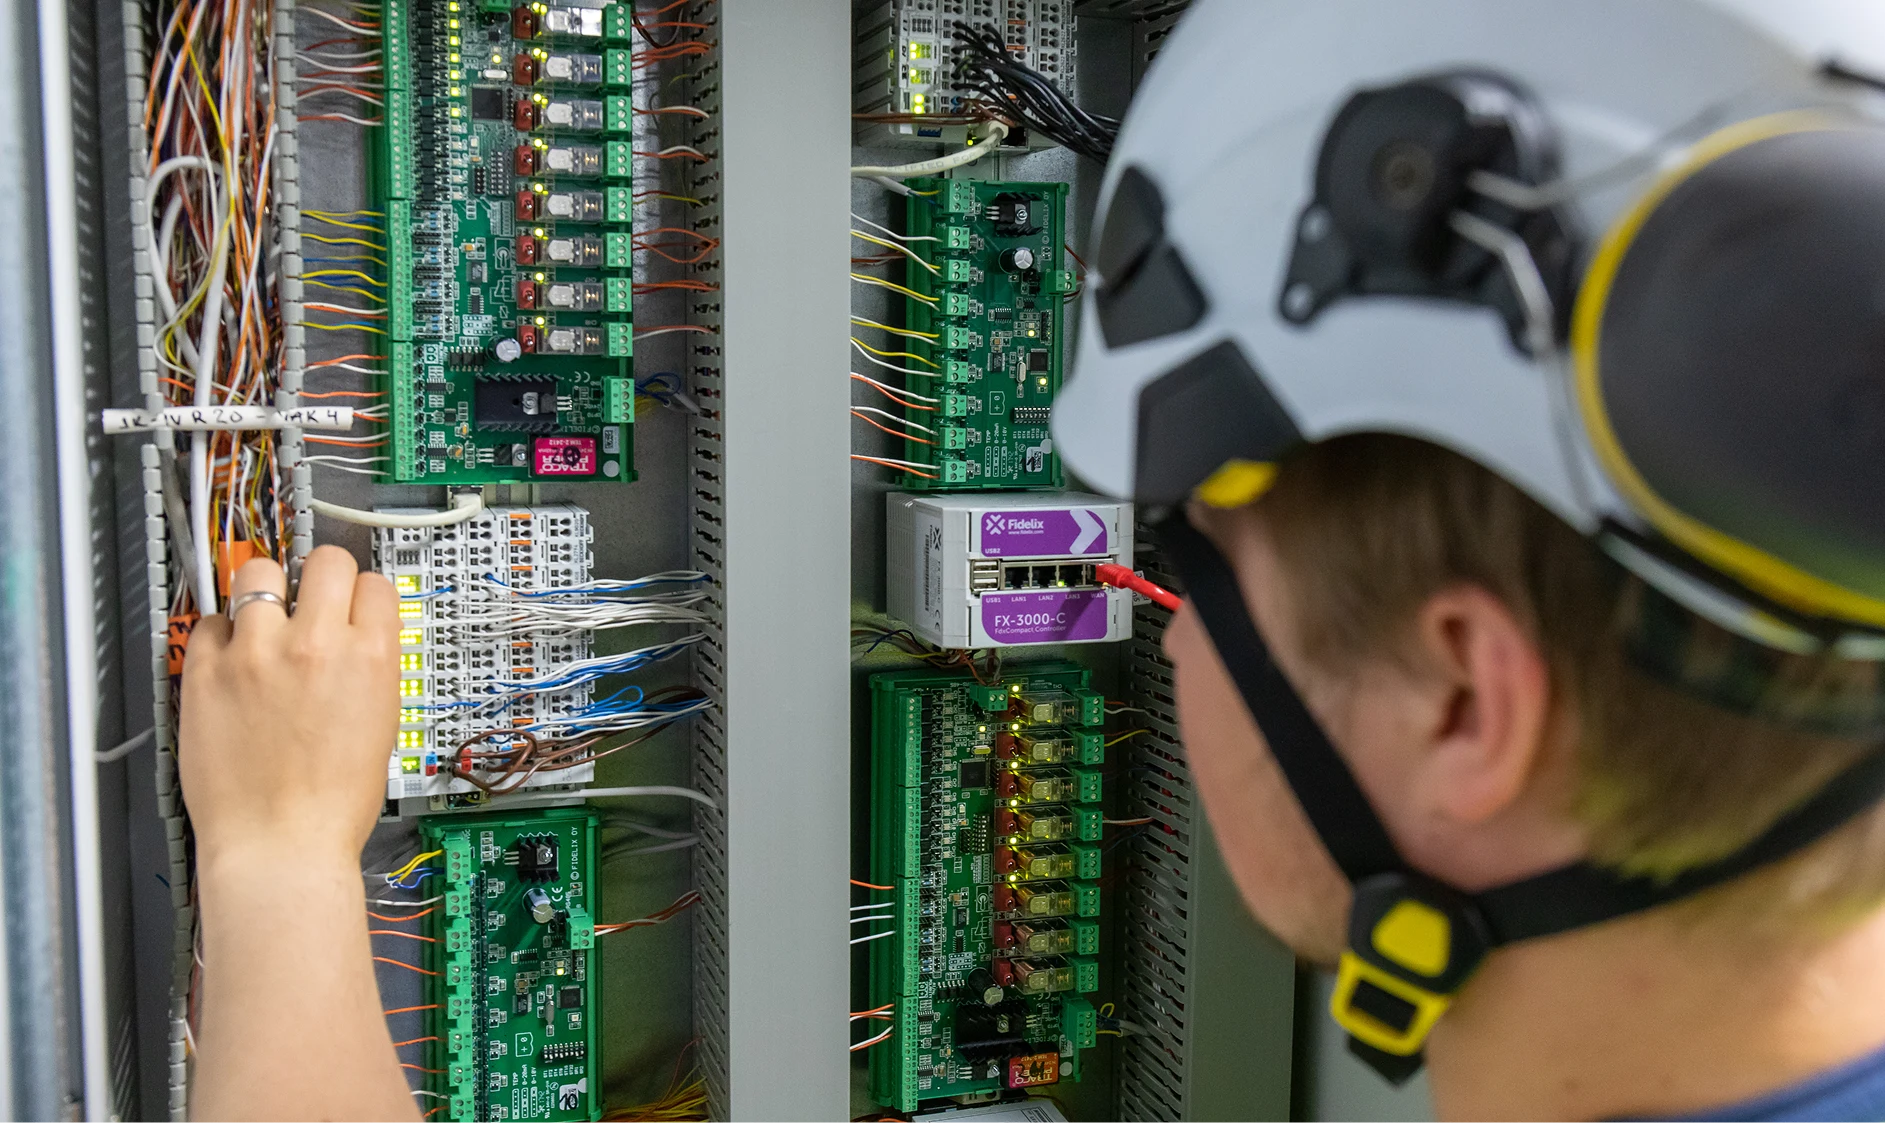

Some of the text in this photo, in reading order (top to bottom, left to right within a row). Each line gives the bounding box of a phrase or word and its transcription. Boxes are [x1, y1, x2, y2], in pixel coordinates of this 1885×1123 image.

[1008, 519, 1044, 529] Fidelix
[995, 612, 1066, 627] FX-3000-C
[572, 826, 578, 836] OY
